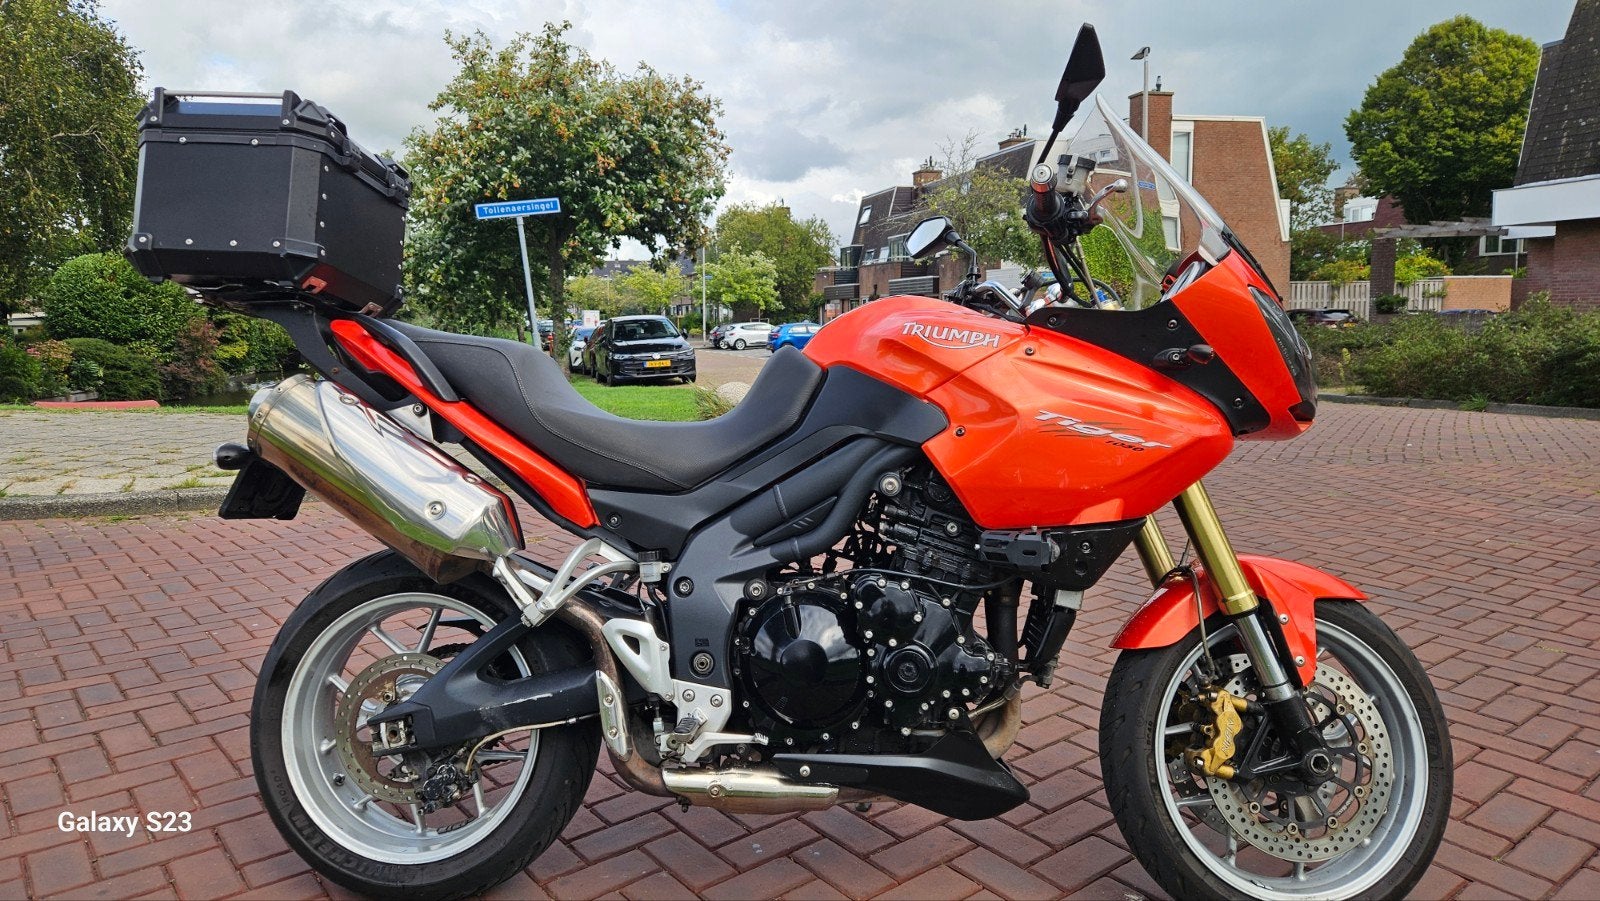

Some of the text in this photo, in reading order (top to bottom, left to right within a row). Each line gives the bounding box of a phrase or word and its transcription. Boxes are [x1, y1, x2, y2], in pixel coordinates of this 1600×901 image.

[482, 202, 554, 215] Tollenaersingel
[902, 322, 1000, 348] TRIUMPH
[1105, 440, 1145, 453] 1050
